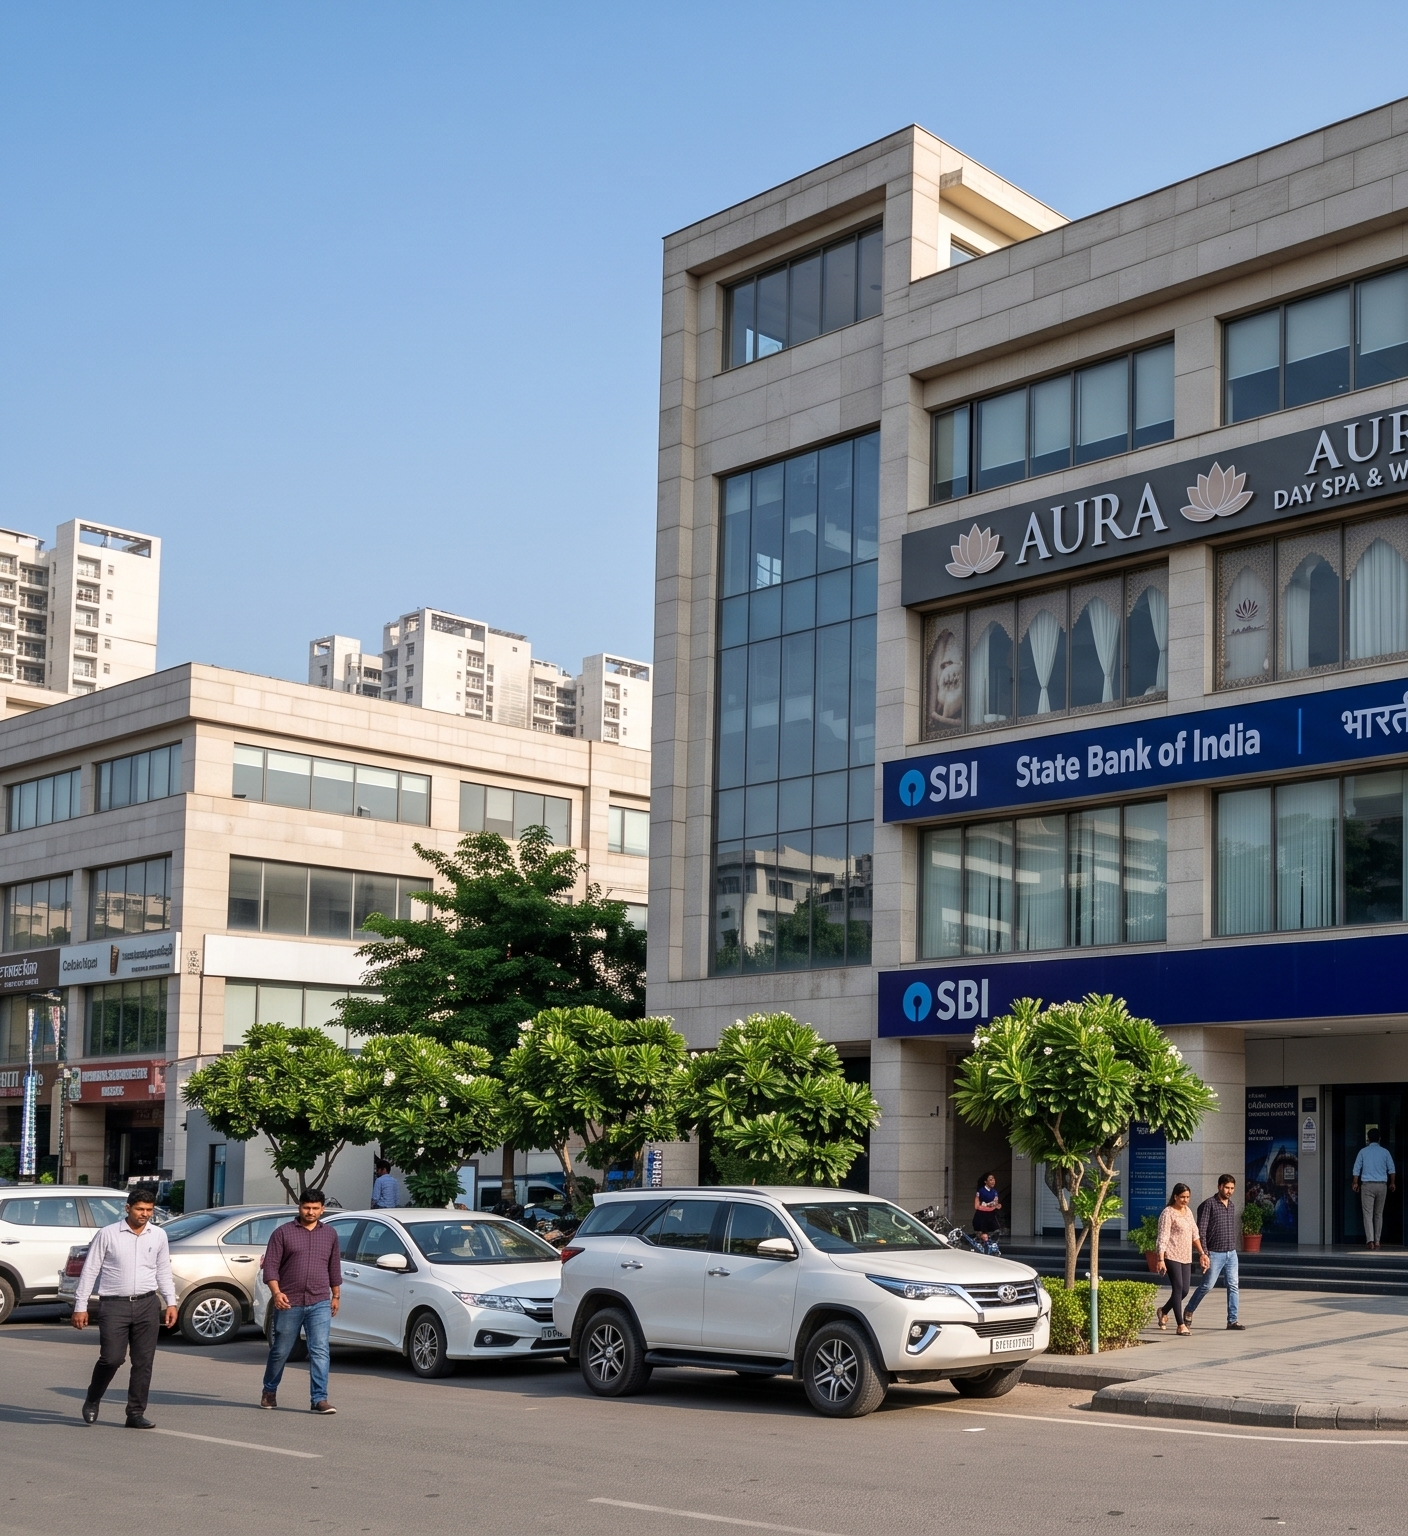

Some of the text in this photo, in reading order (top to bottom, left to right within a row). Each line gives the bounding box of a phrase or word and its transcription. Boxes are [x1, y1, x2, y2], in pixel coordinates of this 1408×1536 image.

[1274, 482, 1316, 509] DAY
[1322, 472, 1360, 499] SPA
[1366, 467, 1384, 488] &
[1015, 482, 1169, 565] AURA
[1016, 722, 1261, 788] State Bank of India
[929, 761, 978, 802] SBI
[936, 978, 989, 1020] SBI
